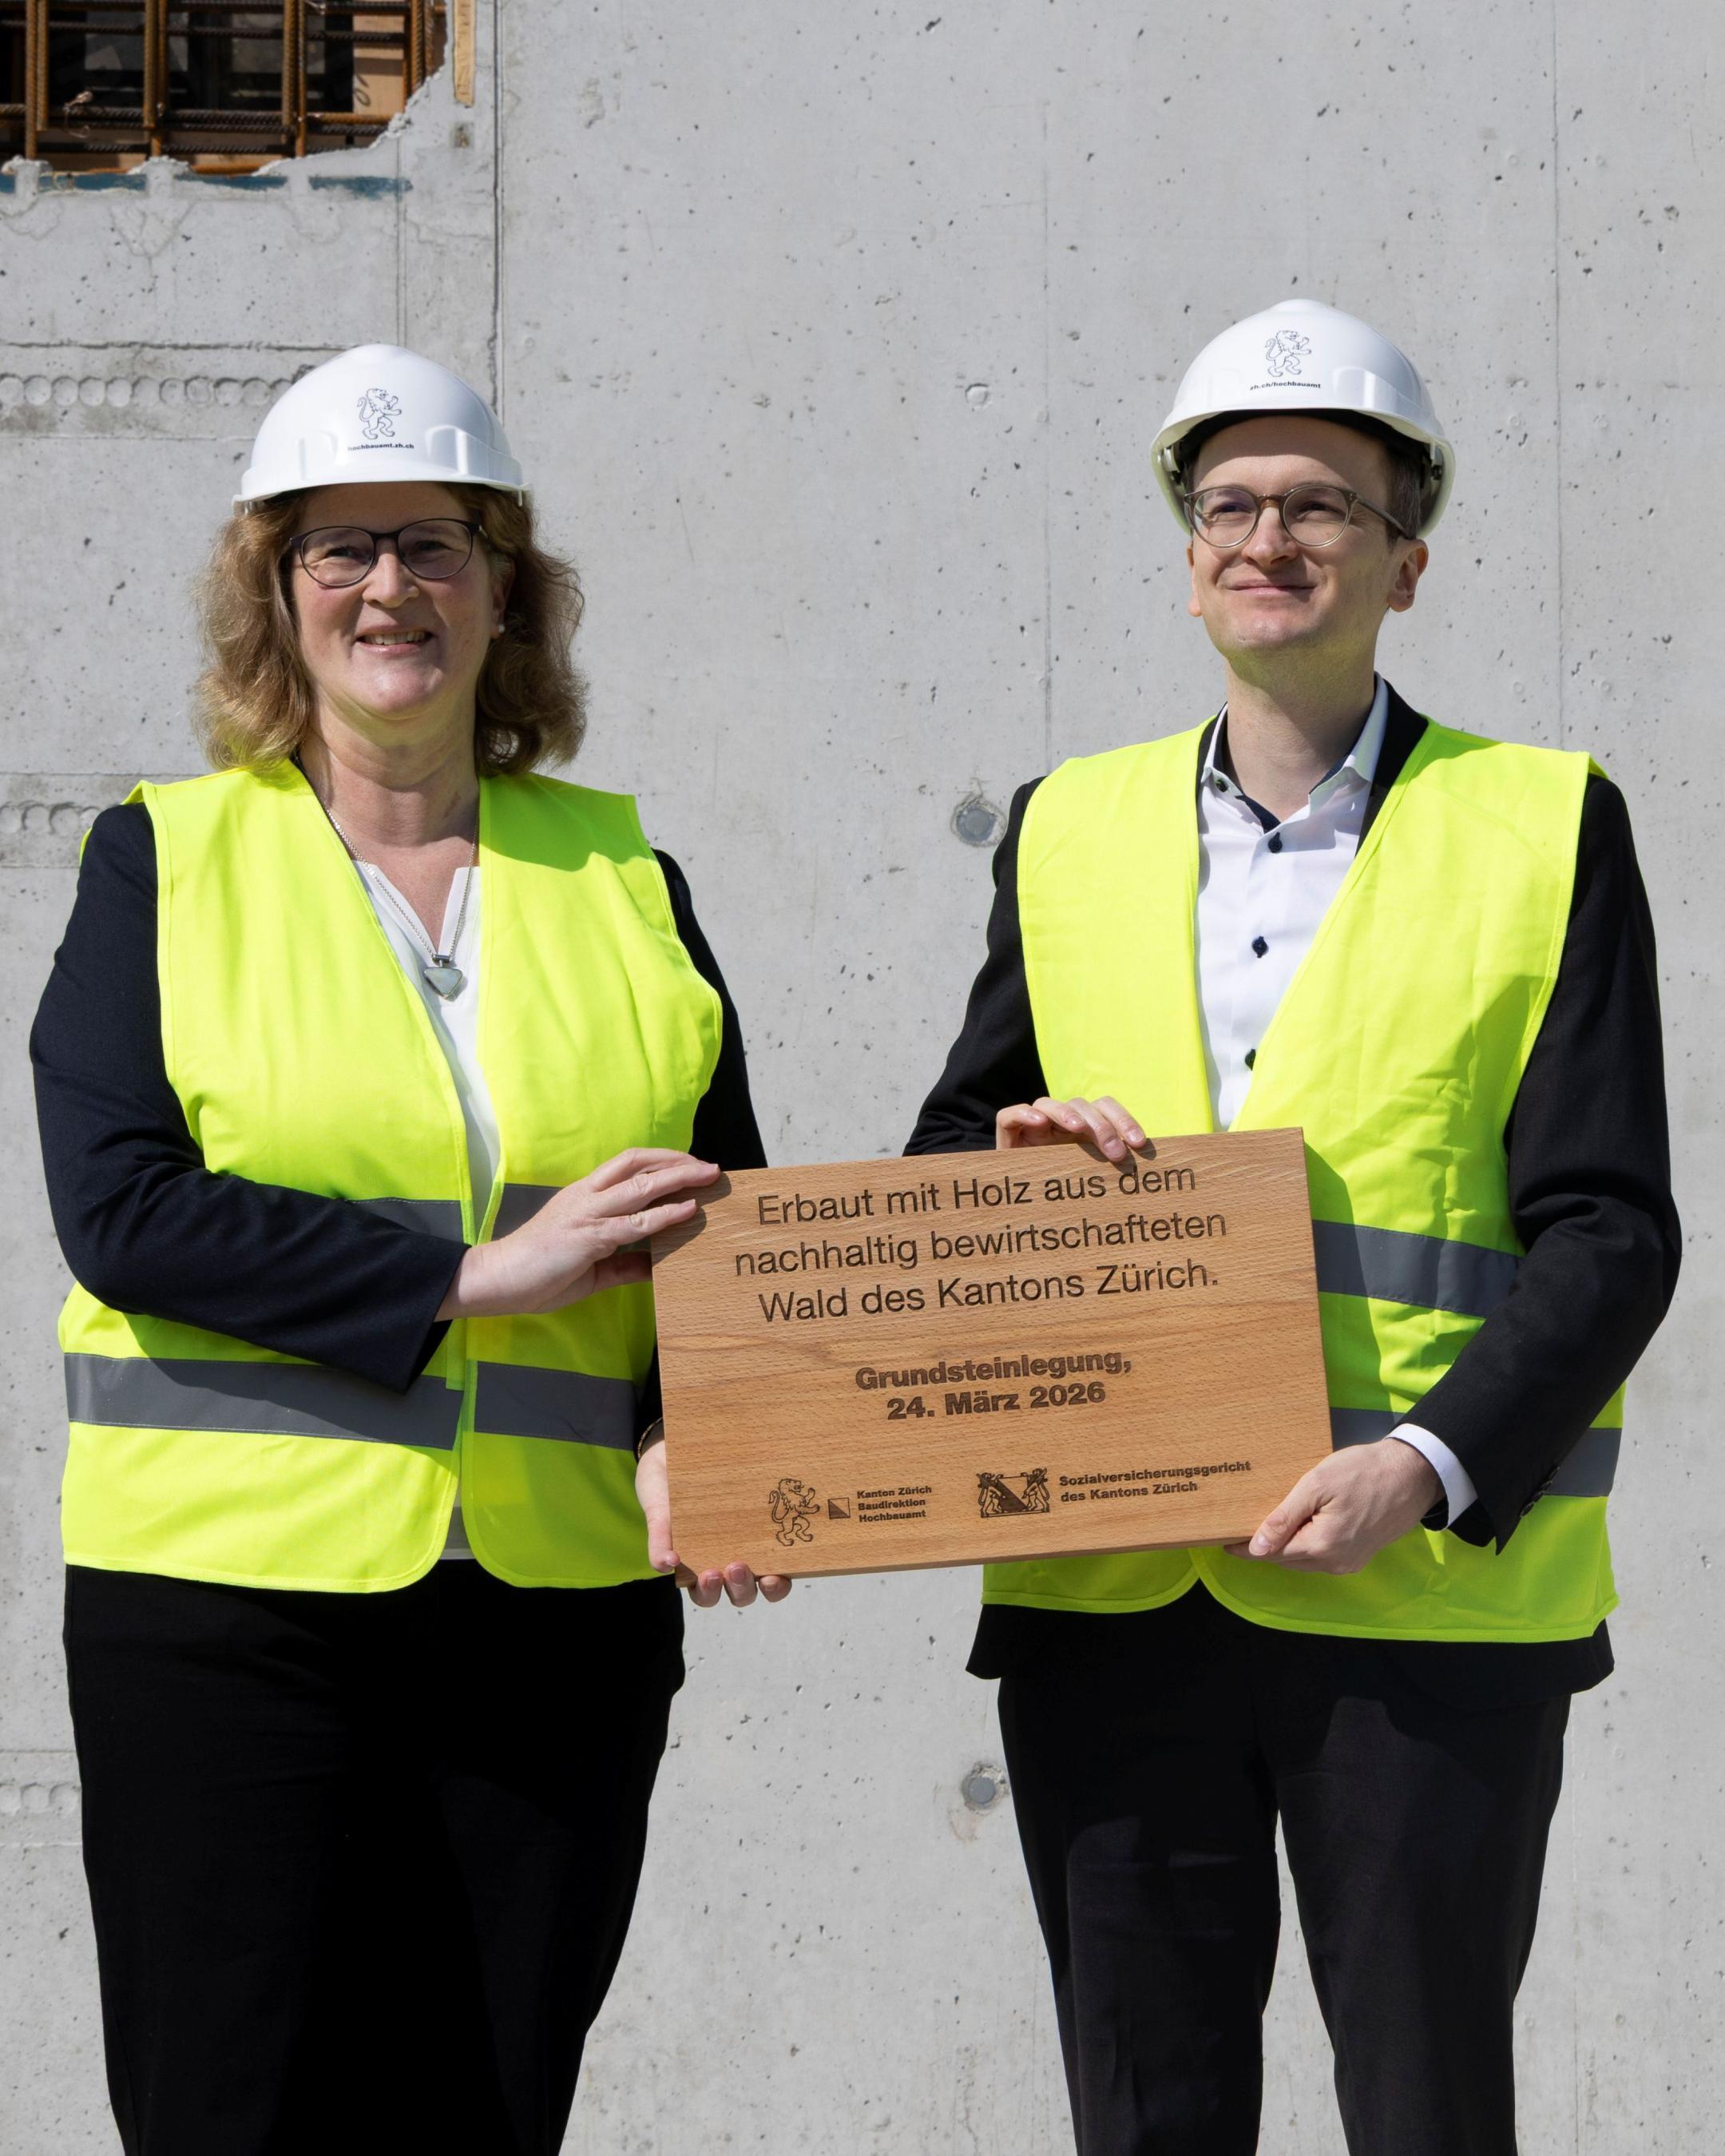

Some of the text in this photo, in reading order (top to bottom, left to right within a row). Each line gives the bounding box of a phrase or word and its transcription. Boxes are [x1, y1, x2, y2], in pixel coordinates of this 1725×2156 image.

[1250, 381, 1321, 390] zh.ch/hochbauamt
[759, 1165, 1196, 1225] Erbaut mit Holz aus dem
[736, 1213, 1227, 1276] nachhaltig bewirtschafteten
[759, 1258, 1218, 1322] Wald des Kantons Zürich.
[855, 1352, 1132, 1390] Grundsteinlegung,
[887, 1381, 1106, 1420] 24. März 2026
[1060, 1461, 1251, 1487] Sozialversicherungsgericht
[857, 1485, 932, 1499] Kanton Zürich
[858, 1499, 926, 1511] Baudirektion
[1061, 1481, 1198, 1503] des Kantons Zürich
[859, 1510, 926, 1523] Hochbauamt
